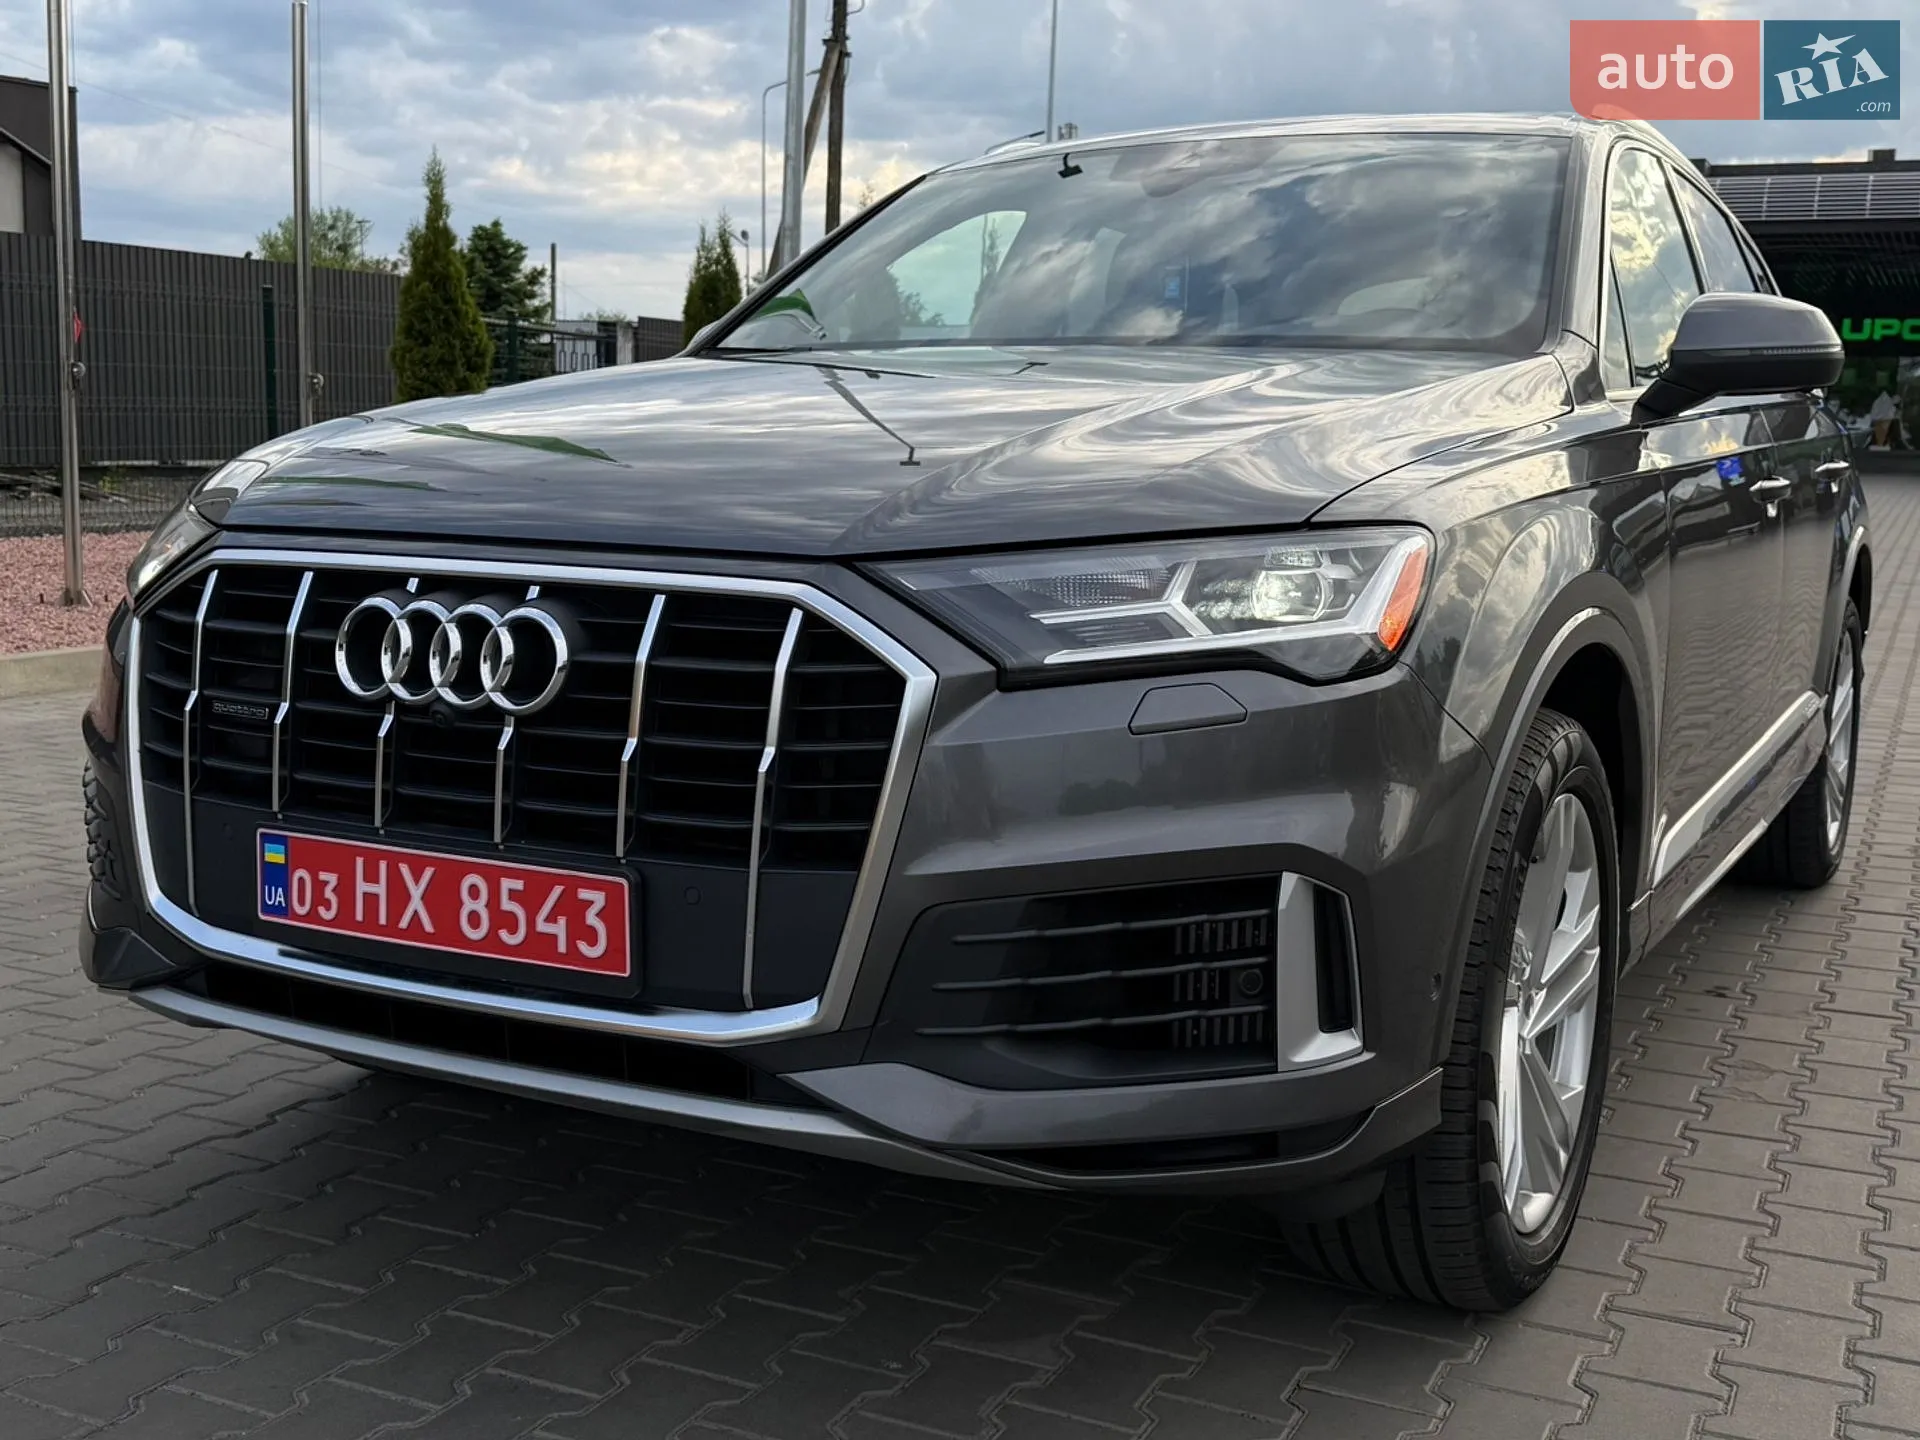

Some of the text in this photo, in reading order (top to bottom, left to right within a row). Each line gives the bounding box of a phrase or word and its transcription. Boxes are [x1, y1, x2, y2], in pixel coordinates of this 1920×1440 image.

[264, 886, 286, 907] UA
[291, 856, 608, 959] 03 HX 8543
